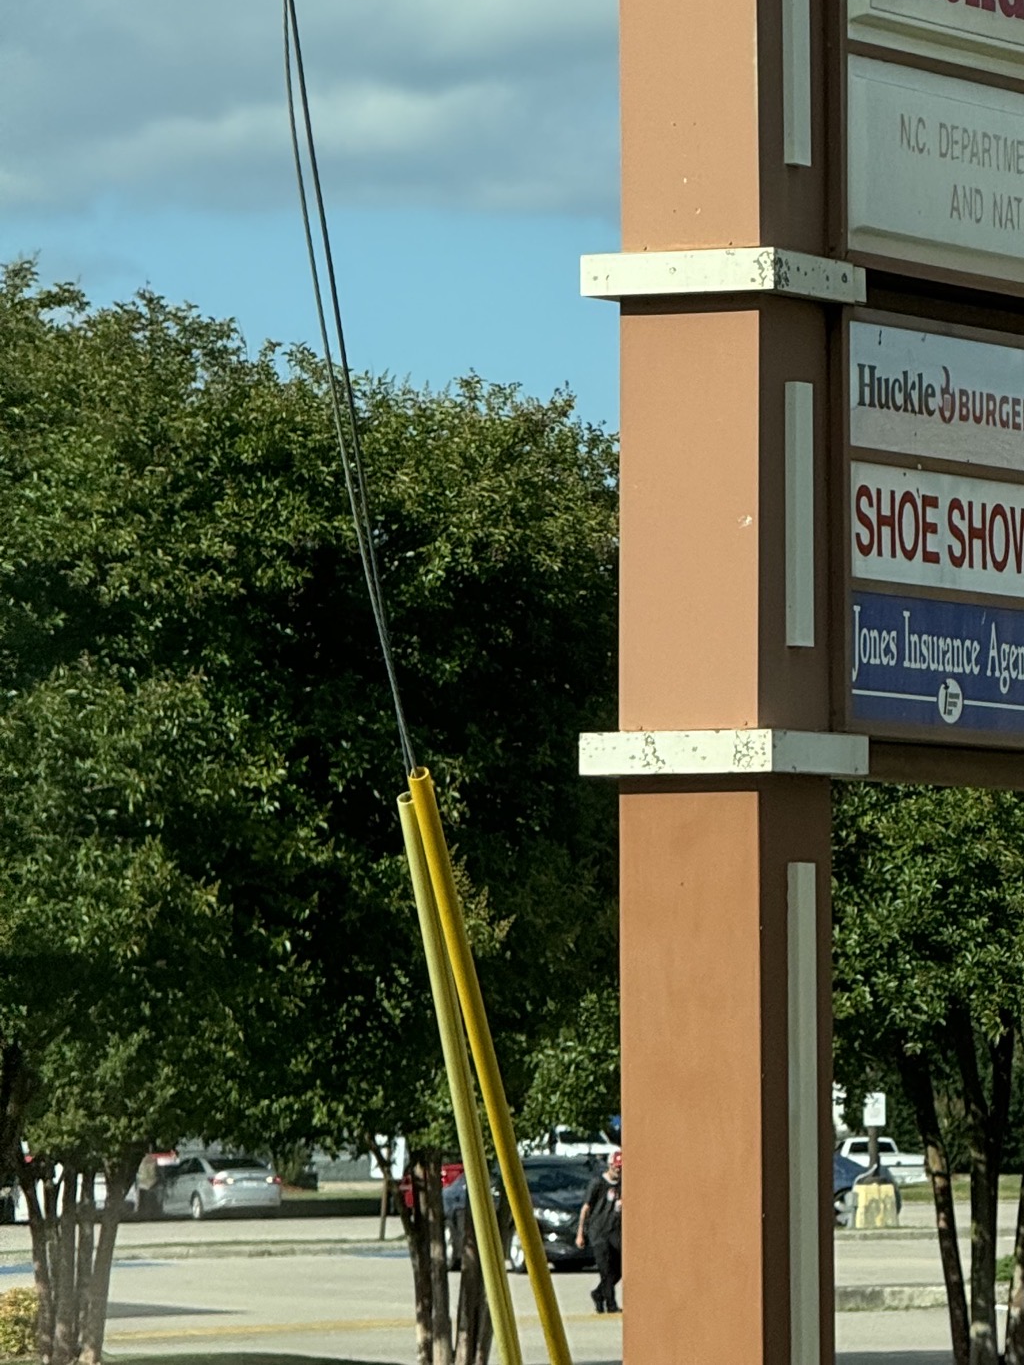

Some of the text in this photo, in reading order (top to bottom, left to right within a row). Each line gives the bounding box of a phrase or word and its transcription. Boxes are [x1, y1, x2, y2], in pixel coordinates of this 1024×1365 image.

[899, 113, 931, 156] N.C.
[950, 184, 984, 225] AND
[857, 363, 936, 417] Huckle
[855, 484, 941, 565] SHOE
[852, 605, 897, 682] Jones
[903, 610, 981, 675] Insurance
